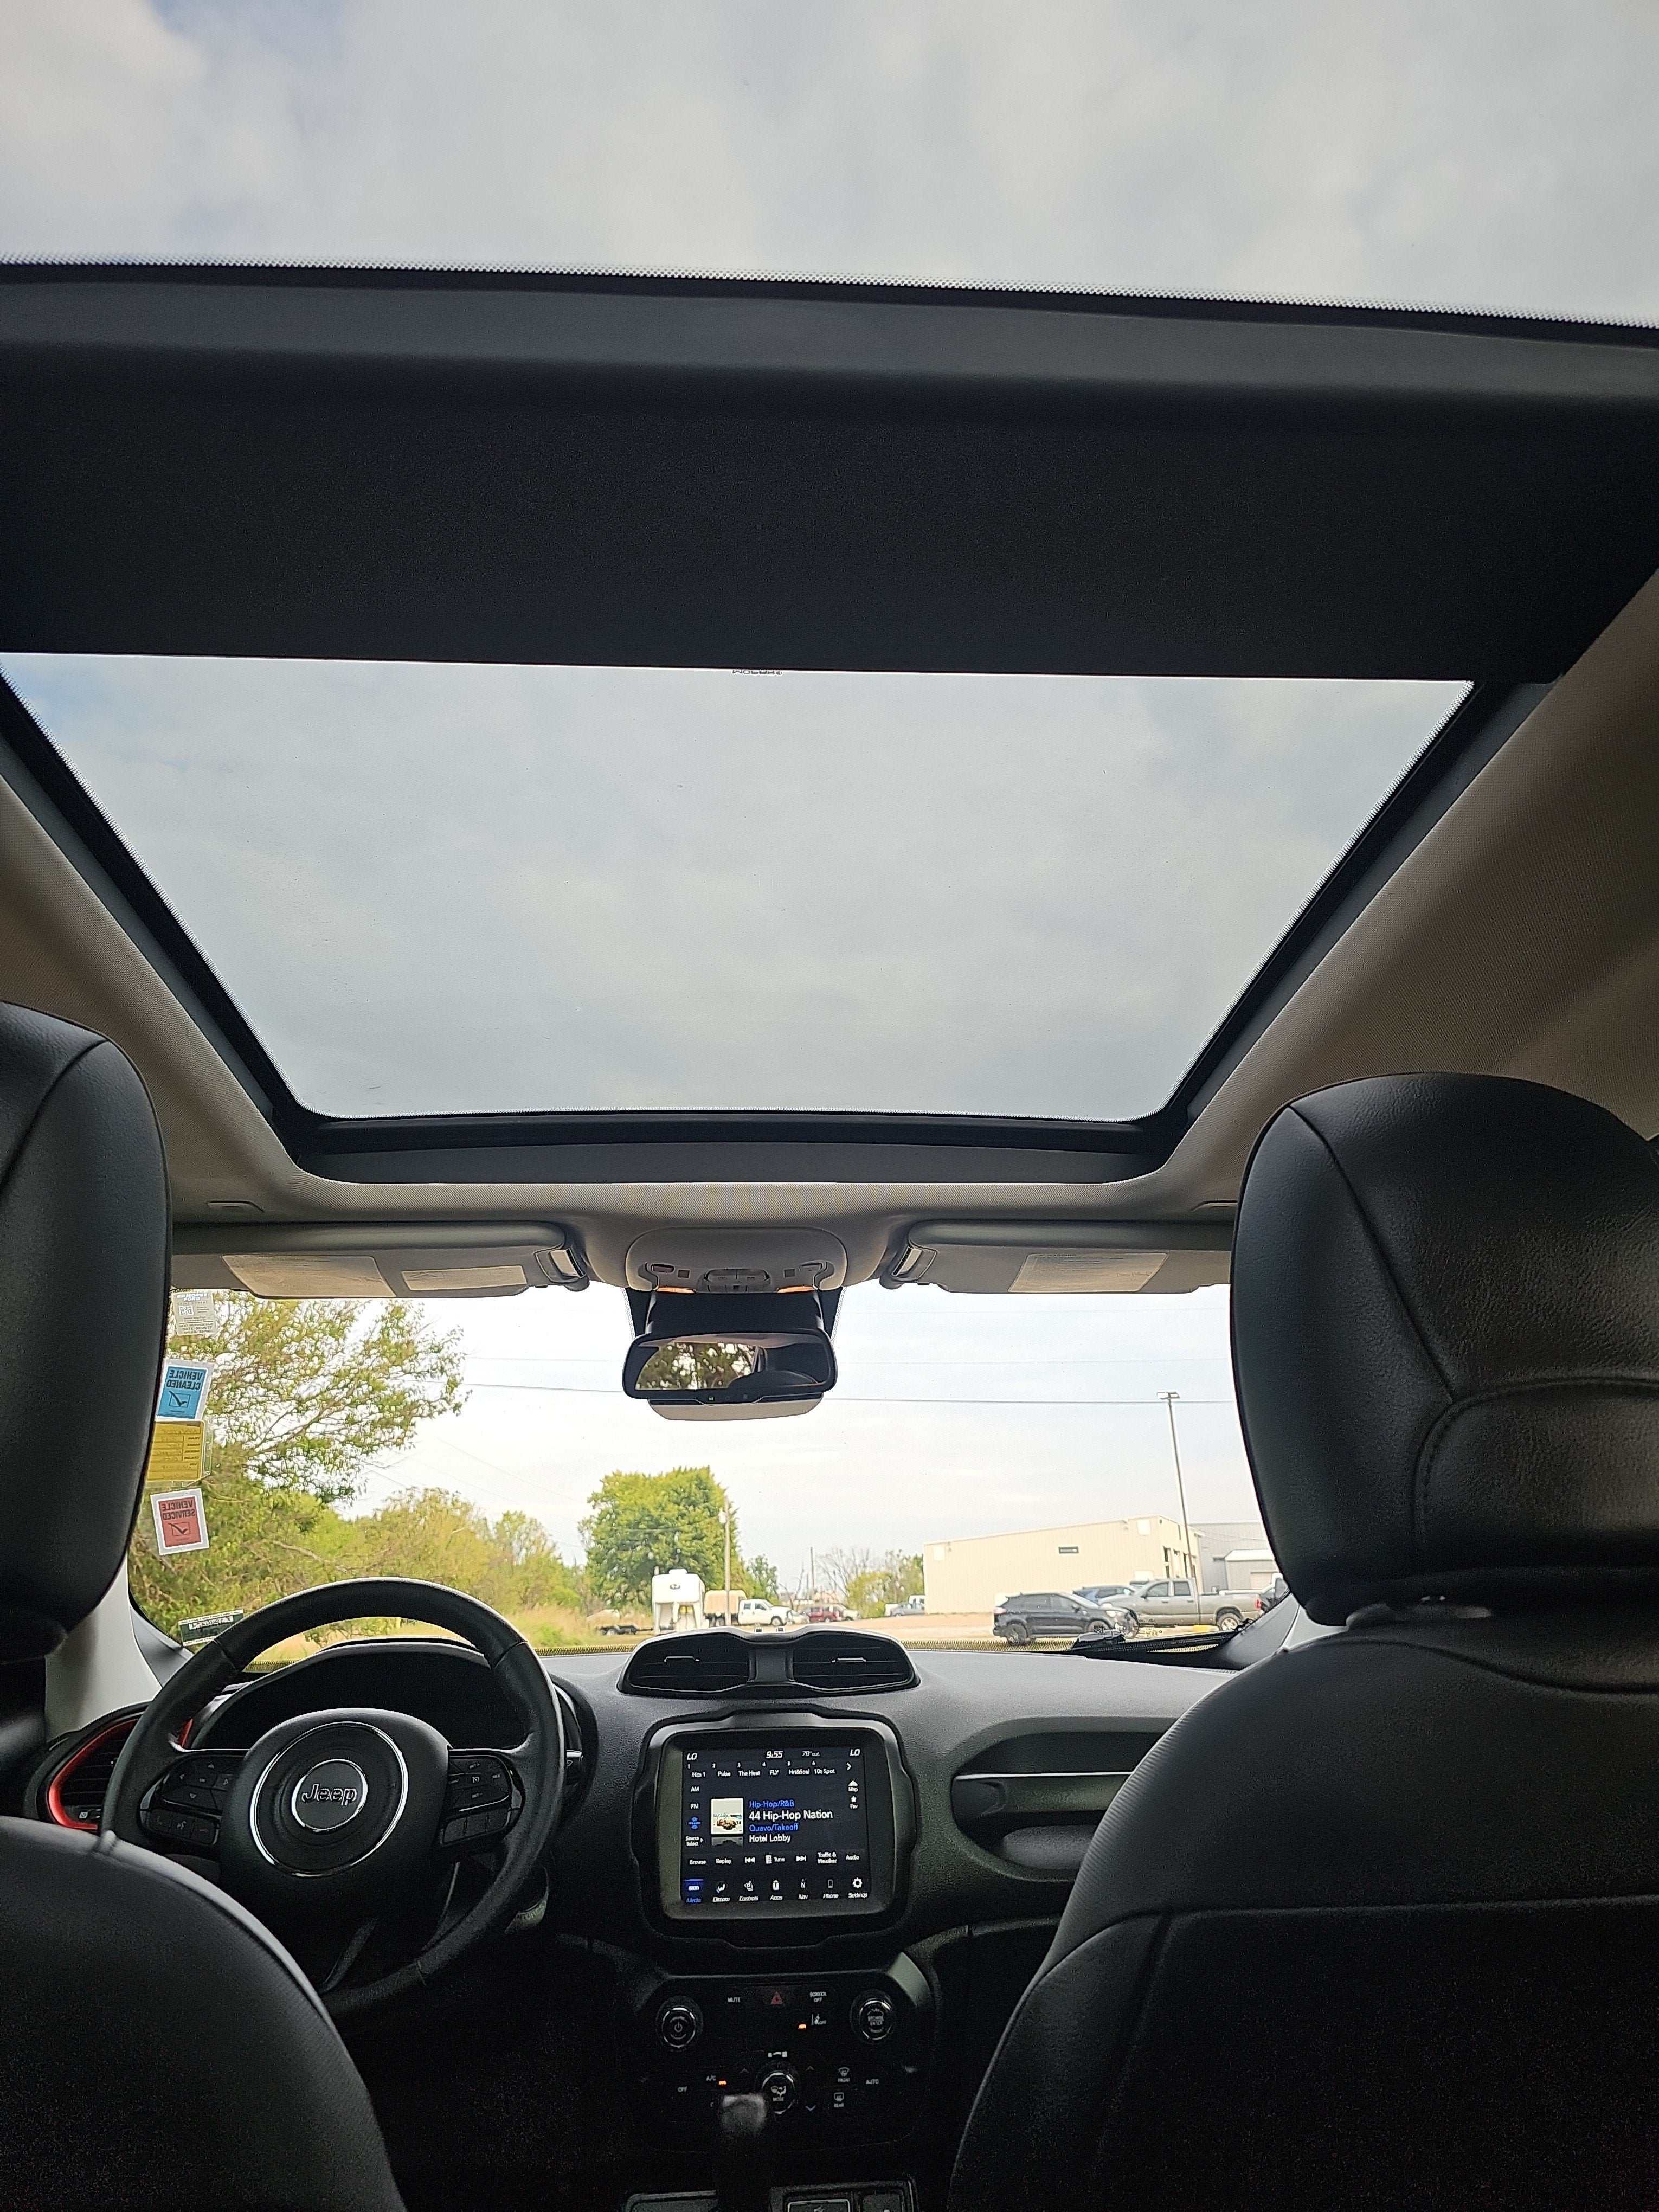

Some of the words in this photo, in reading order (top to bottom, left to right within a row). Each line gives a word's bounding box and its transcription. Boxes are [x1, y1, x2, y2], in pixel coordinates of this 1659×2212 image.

[301, 1784, 357, 1806] Jeep
[749, 1800, 794, 1809] Hip-Hop/R&B
[749, 1811, 760, 1821] 44
[763, 1810, 801, 1822] Hip-Hop
[803, 1810, 833, 1819] Nation
[749, 1823, 799, 1832] Quavo/Takeoff
[749, 1834, 768, 1842] Hotel
[770, 1834, 790, 1843] Lobby
